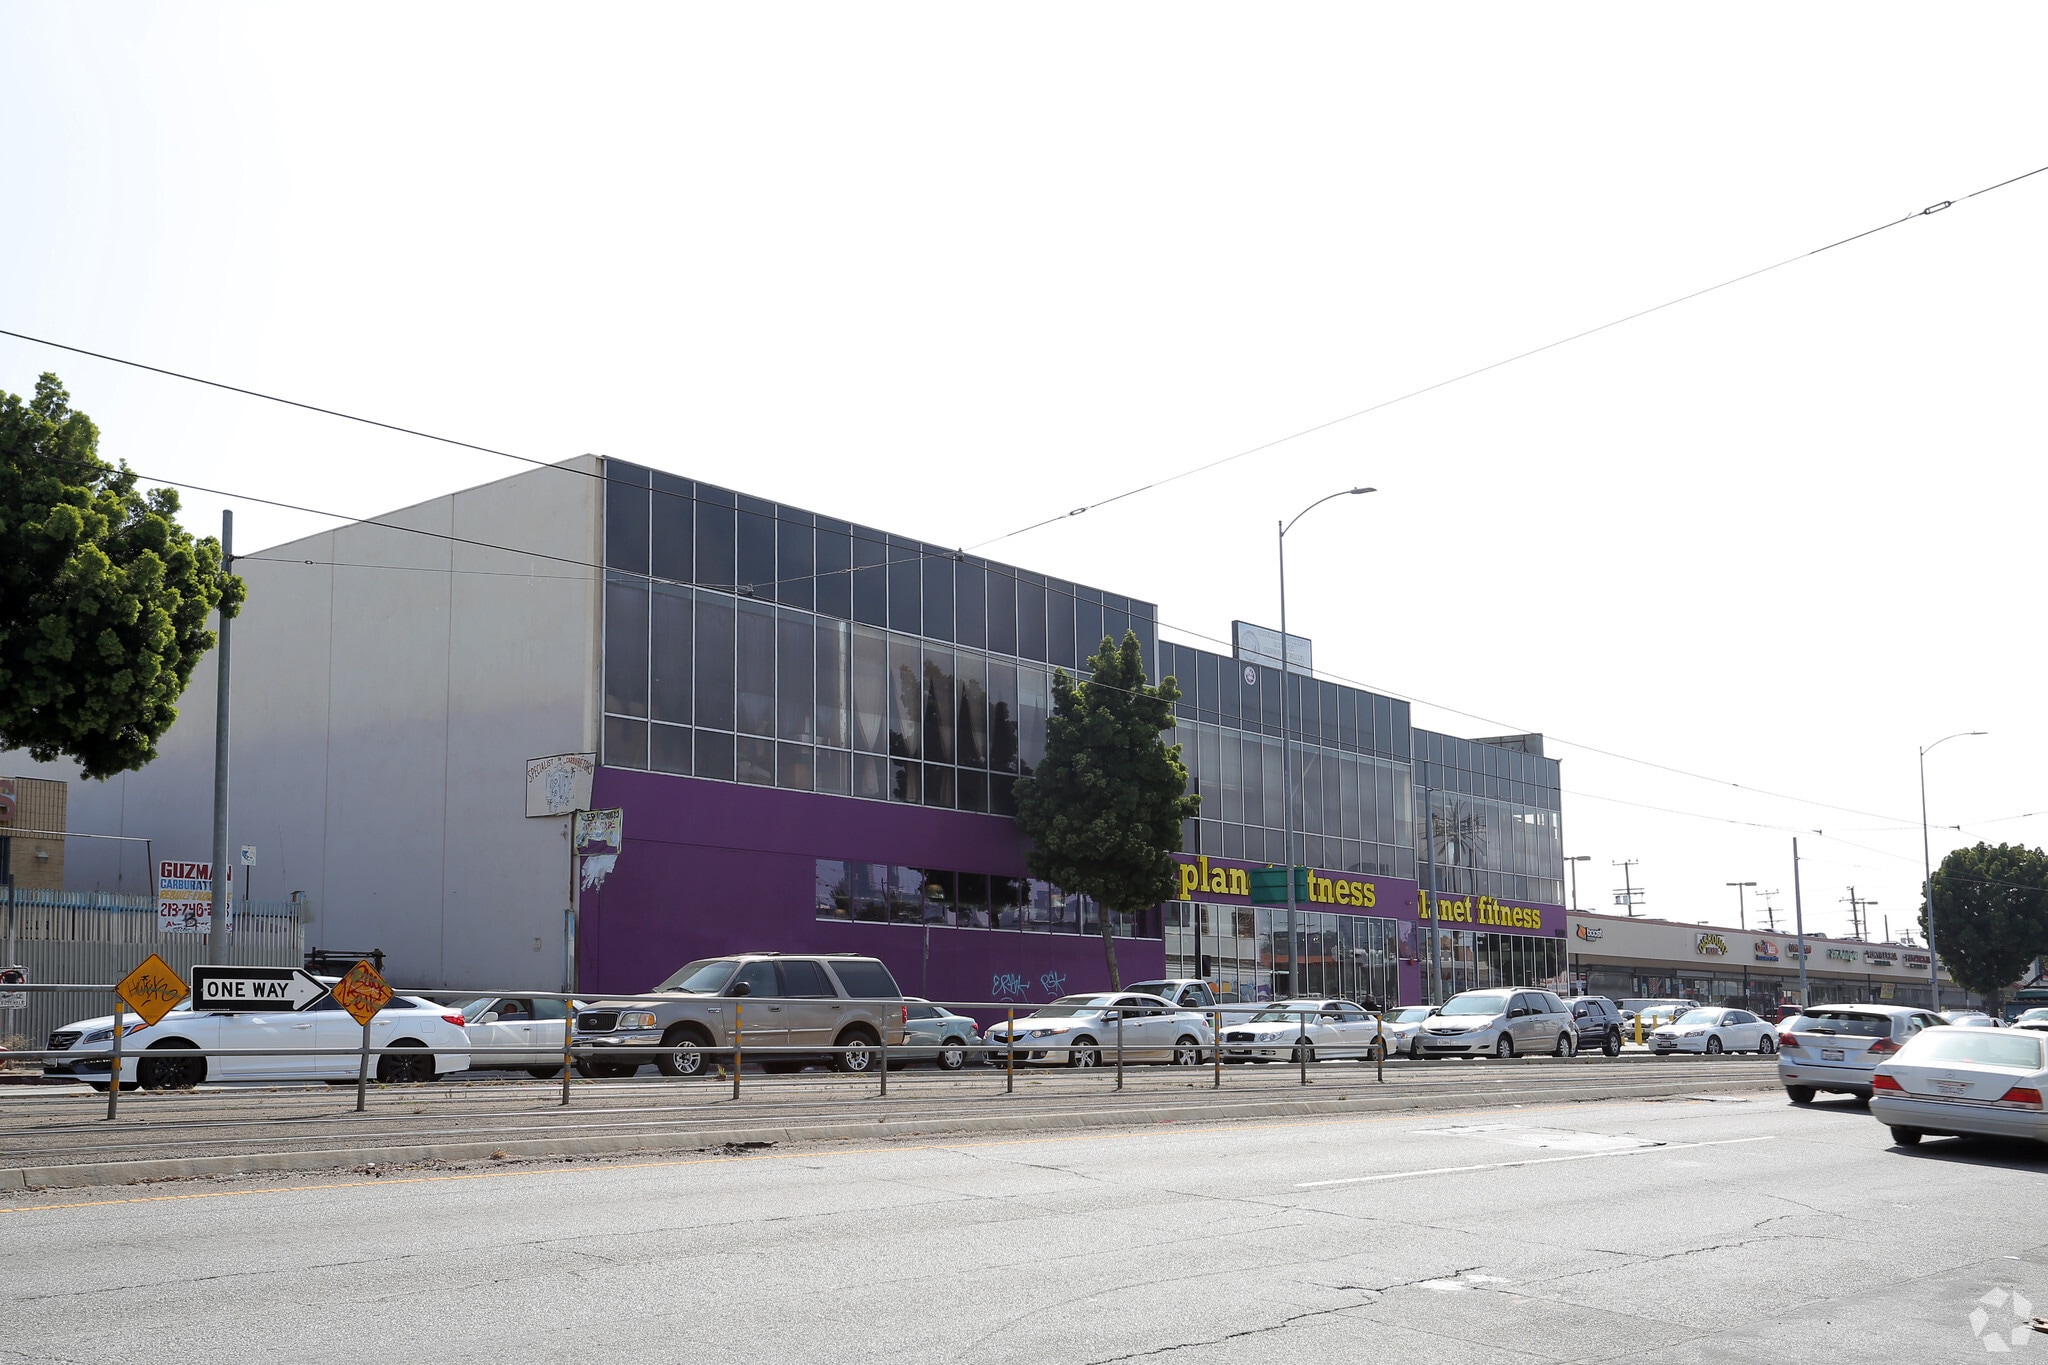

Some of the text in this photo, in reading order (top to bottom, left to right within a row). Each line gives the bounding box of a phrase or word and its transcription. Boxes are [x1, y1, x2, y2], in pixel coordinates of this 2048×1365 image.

[1477, 895, 1541, 930] fitness
[206, 981, 290, 998] ONE WAY
